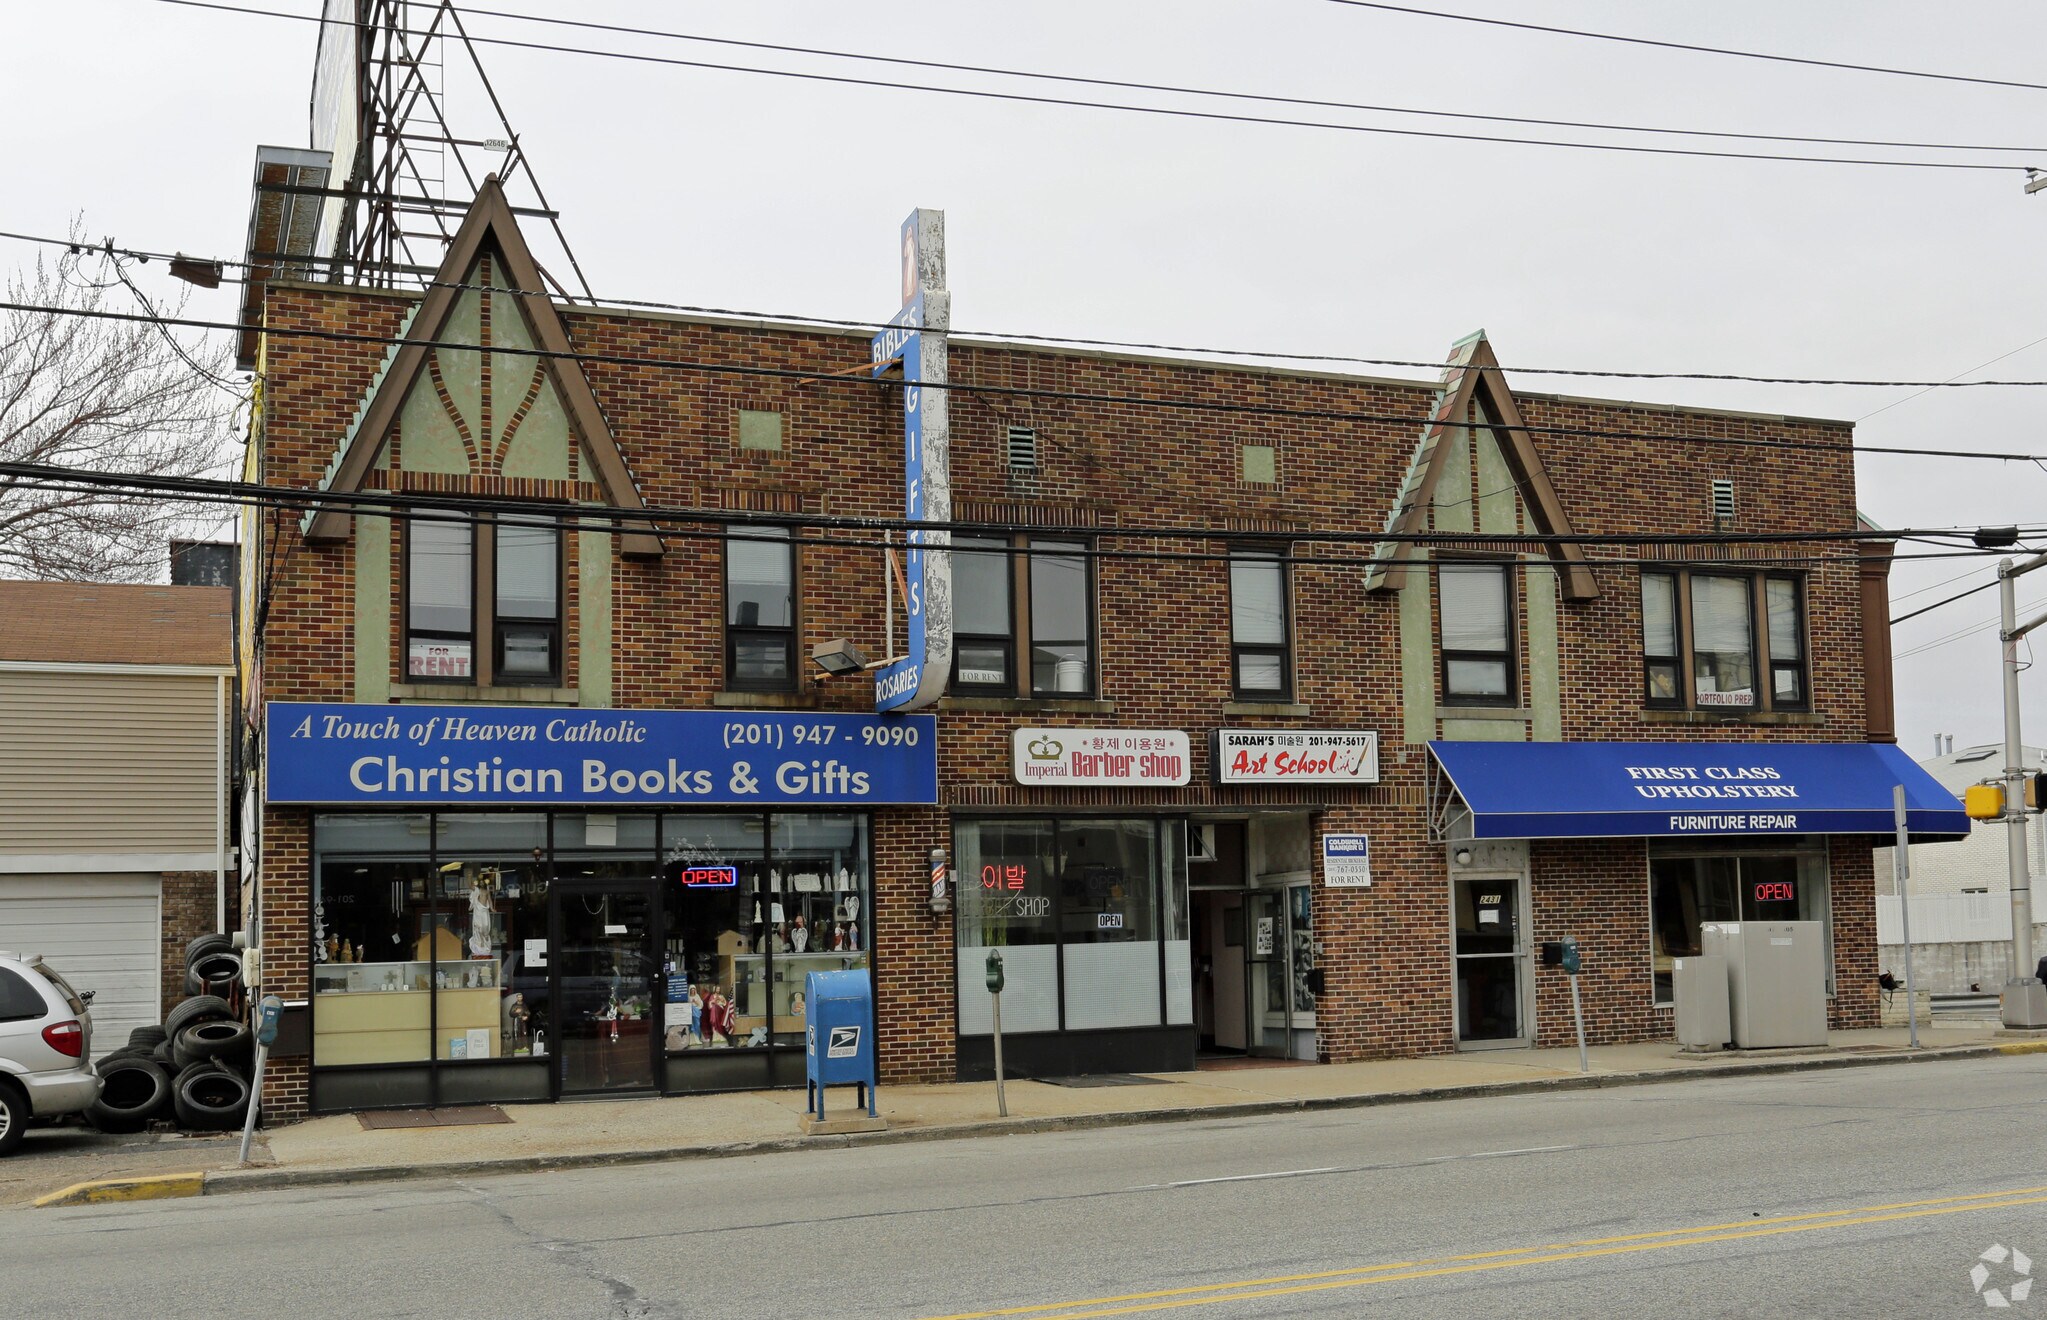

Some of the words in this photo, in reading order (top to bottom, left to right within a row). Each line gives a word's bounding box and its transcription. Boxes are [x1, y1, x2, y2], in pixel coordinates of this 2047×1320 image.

[873, 305, 917, 371] BIBLES
[906, 378, 920, 616] GIFTS
[409, 657, 468, 676] RENT
[876, 665, 918, 703] ROSARIES
[962, 672, 979, 681] FOR
[982, 673, 1003, 682] RENT
[1696, 693, 1732, 704] PORTFOLIO
[1735, 694, 1753, 705] PREP.
[290, 714, 312, 738] A
[322, 715, 400, 739] Touch
[408, 717, 440, 746] of
[441, 717, 537, 741] Heaven
[545, 718, 647, 744] Catholic
[723, 723, 784, 749] (201)
[792, 725, 836, 745] 947
[861, 726, 919, 746] 9090
[1092, 737, 1120, 750] 황제
[1125, 737, 1166, 750] 이용원
[1228, 736, 1274, 746] SARAH'S
[1278, 736, 1304, 746] 미술원
[1309, 736, 1366, 747] 201-947-5617
[1025, 762, 1068, 779] Imperial
[1071, 751, 1135, 778] Barber
[1139, 752, 1182, 781] shop
[1231, 750, 1268, 776] Art
[1274, 750, 1339, 776] School
[349, 755, 563, 793] Christian
[582, 758, 713, 794] Books
[729, 761, 760, 794] &
[775, 760, 870, 795] Gifts
[1625, 767, 1700, 779] FIRST
[1704, 767, 1781, 779] CLASS
[1634, 785, 1800, 798] UPHOLSTERY
[1670, 816, 1746, 830] FURNITURE
[1750, 815, 1797, 829] REPAIR
[682, 870, 732, 883] OPEN
[981, 864, 1026, 890] 이발
[1480, 895, 1500, 903] 2431
[1756, 884, 1793, 900] OPEN
[1016, 897, 1050, 916] SHOP
[1100, 915, 1121, 927] OPEN
